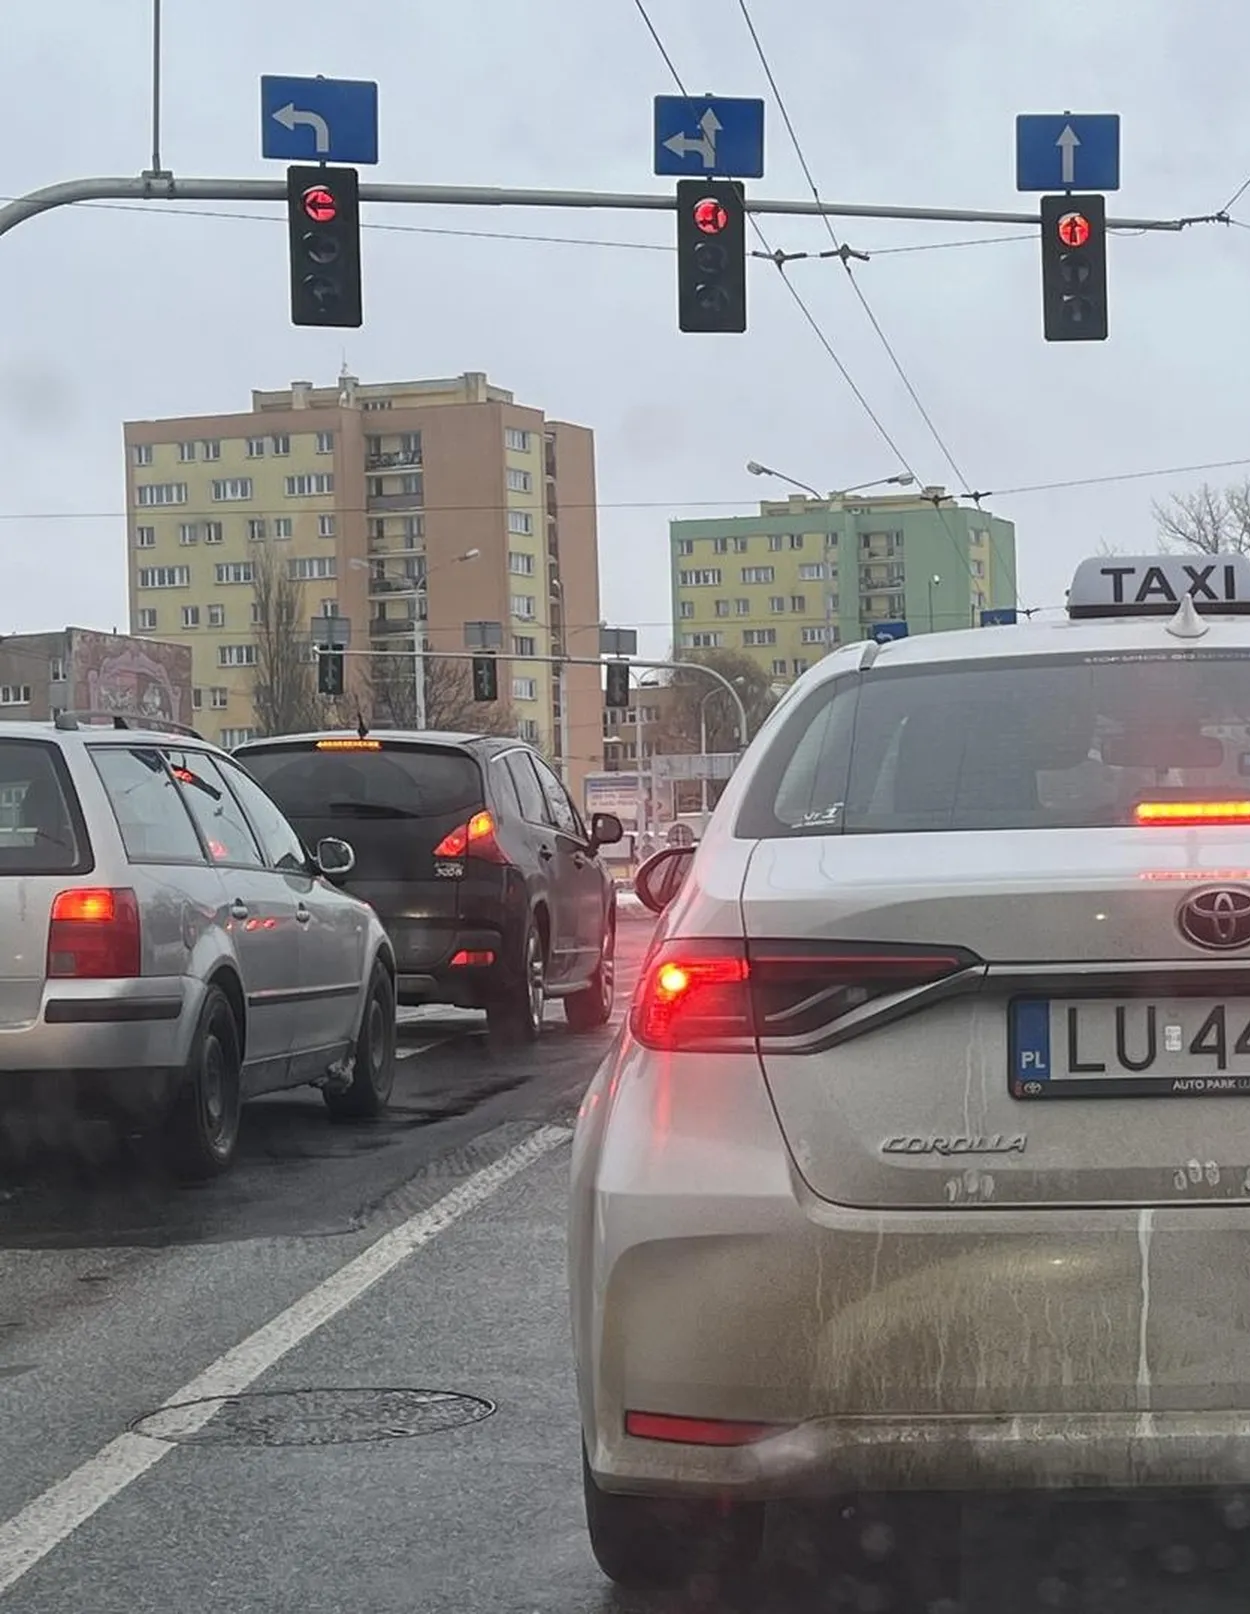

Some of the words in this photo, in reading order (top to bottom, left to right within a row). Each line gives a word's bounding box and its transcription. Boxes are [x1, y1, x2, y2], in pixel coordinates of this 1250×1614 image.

[1101, 565, 1236, 603] TAXI
[1068, 1005, 1157, 1073] LU
[1021, 1051, 1046, 1069] PL
[1172, 1079, 1205, 1090] AUTO
[1206, 1079, 1237, 1089] PARK
[881, 1133, 1028, 1156] COROLLA
